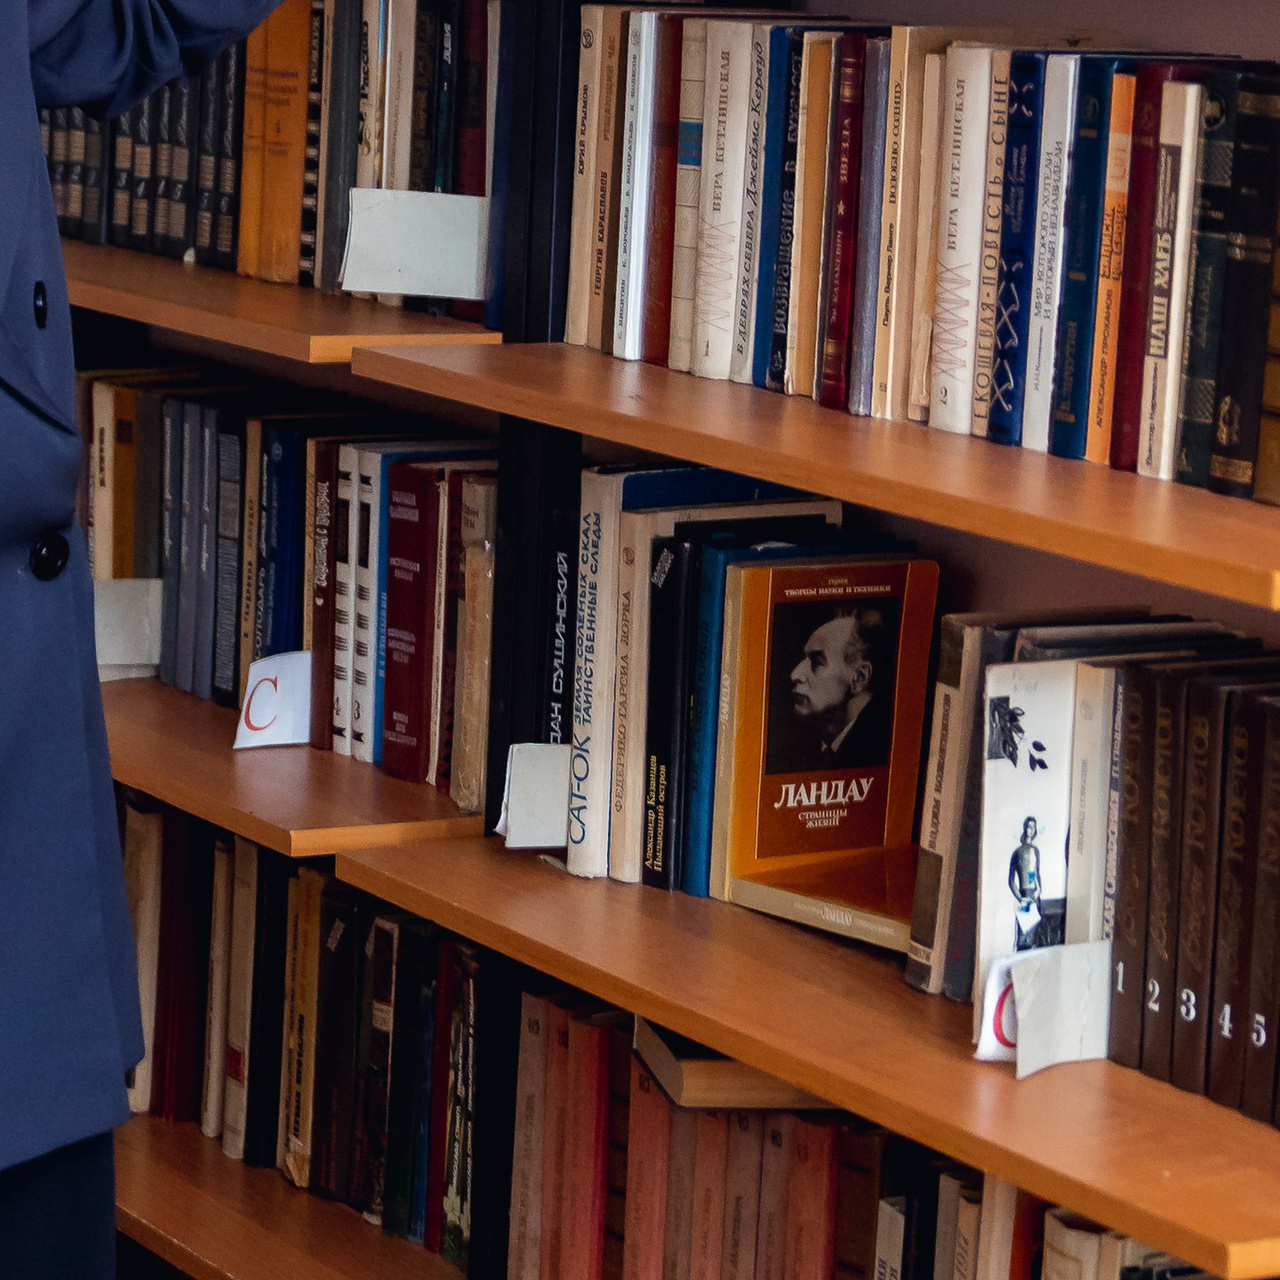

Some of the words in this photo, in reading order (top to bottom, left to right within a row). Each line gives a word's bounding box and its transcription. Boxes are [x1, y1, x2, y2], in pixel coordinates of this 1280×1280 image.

[580, 83, 589, 136] КРЫМОВ
[715, 49, 730, 163] КЕТЛИНСКАЯ
[750, 40, 766, 116] Кервуд
[949, 78, 966, 199] КЕТЛИНСКАЯ
[991, 74, 1010, 146] СЫНЕ
[577, 139, 586, 176] ЮРИЙ
[746, 120, 762, 207] Джеймс
[839, 116, 851, 184] ЗВЕЗДА
[888, 140, 900, 205] ПОДОБНО
[1041, 151, 1053, 207] ХОТЕЛИ
[597, 171, 608, 242] КАРАСЛАВОВ
[712, 171, 724, 212] ВЕРА
[1047, 140, 1062, 236] НЕНАВИДЕЛИ
[742, 210, 756, 273] СЕВЕРА
[946, 207, 959, 251] ВЕРА
[981, 175, 1003, 285] ПОВЕСТЬ
[1036, 211, 1050, 282] КОТОРОГО
[593, 247, 605, 296] ГЕОРГИЙ
[738, 275, 751, 342] ДЕБРЯХ
[1101, 288, 1113, 354] ПРОХАНОВ
[1150, 297, 1169, 357] НАШ
[974, 302, 995, 403] КОШЕВАЯ
[1096, 357, 1107, 429] АЛЕКСАНДР
[580, 510, 592, 567] СКАЛ
[588, 510, 603, 576] СЛЕДЫ
[552, 550, 569, 694] СУШИНСКИЙ
[576, 573, 588, 658] СОЛЕНЫХ
[620, 590, 631, 646] ЛОРКА
[784, 588, 817, 596] ТВОРЦЫ
[818, 587, 844, 595] НАУКИ
[853, 585, 891, 593] ТЕХНИКИ
[581, 580, 599, 726] ТАИНСТВЕННЫЕ
[243, 677, 278, 732] С
[573, 666, 585, 726] ЗЕМЛЯ
[618, 653, 629, 721] ГАРСИА
[570, 731, 591, 846] САТ-ОК
[614, 723, 627, 814] ФЕДЕРИКО
[646, 755, 658, 807] Казанцев
[657, 765, 667, 802] остров
[773, 777, 874, 808] ЛАНДАУ
[644, 809, 656, 869] Александр
[653, 804, 665, 872] Пылающий
[798, 808, 848, 821] СТРАНИЦЫ
[806, 818, 839, 829] ЖИЗНИ
[1116, 962, 1124, 993] 1
[1147, 978, 1160, 1012] 2
[1180, 989, 1196, 1021] 3
[1220, 1004, 1232, 1038] 4
[1251, 1014, 1267, 1047] 5
